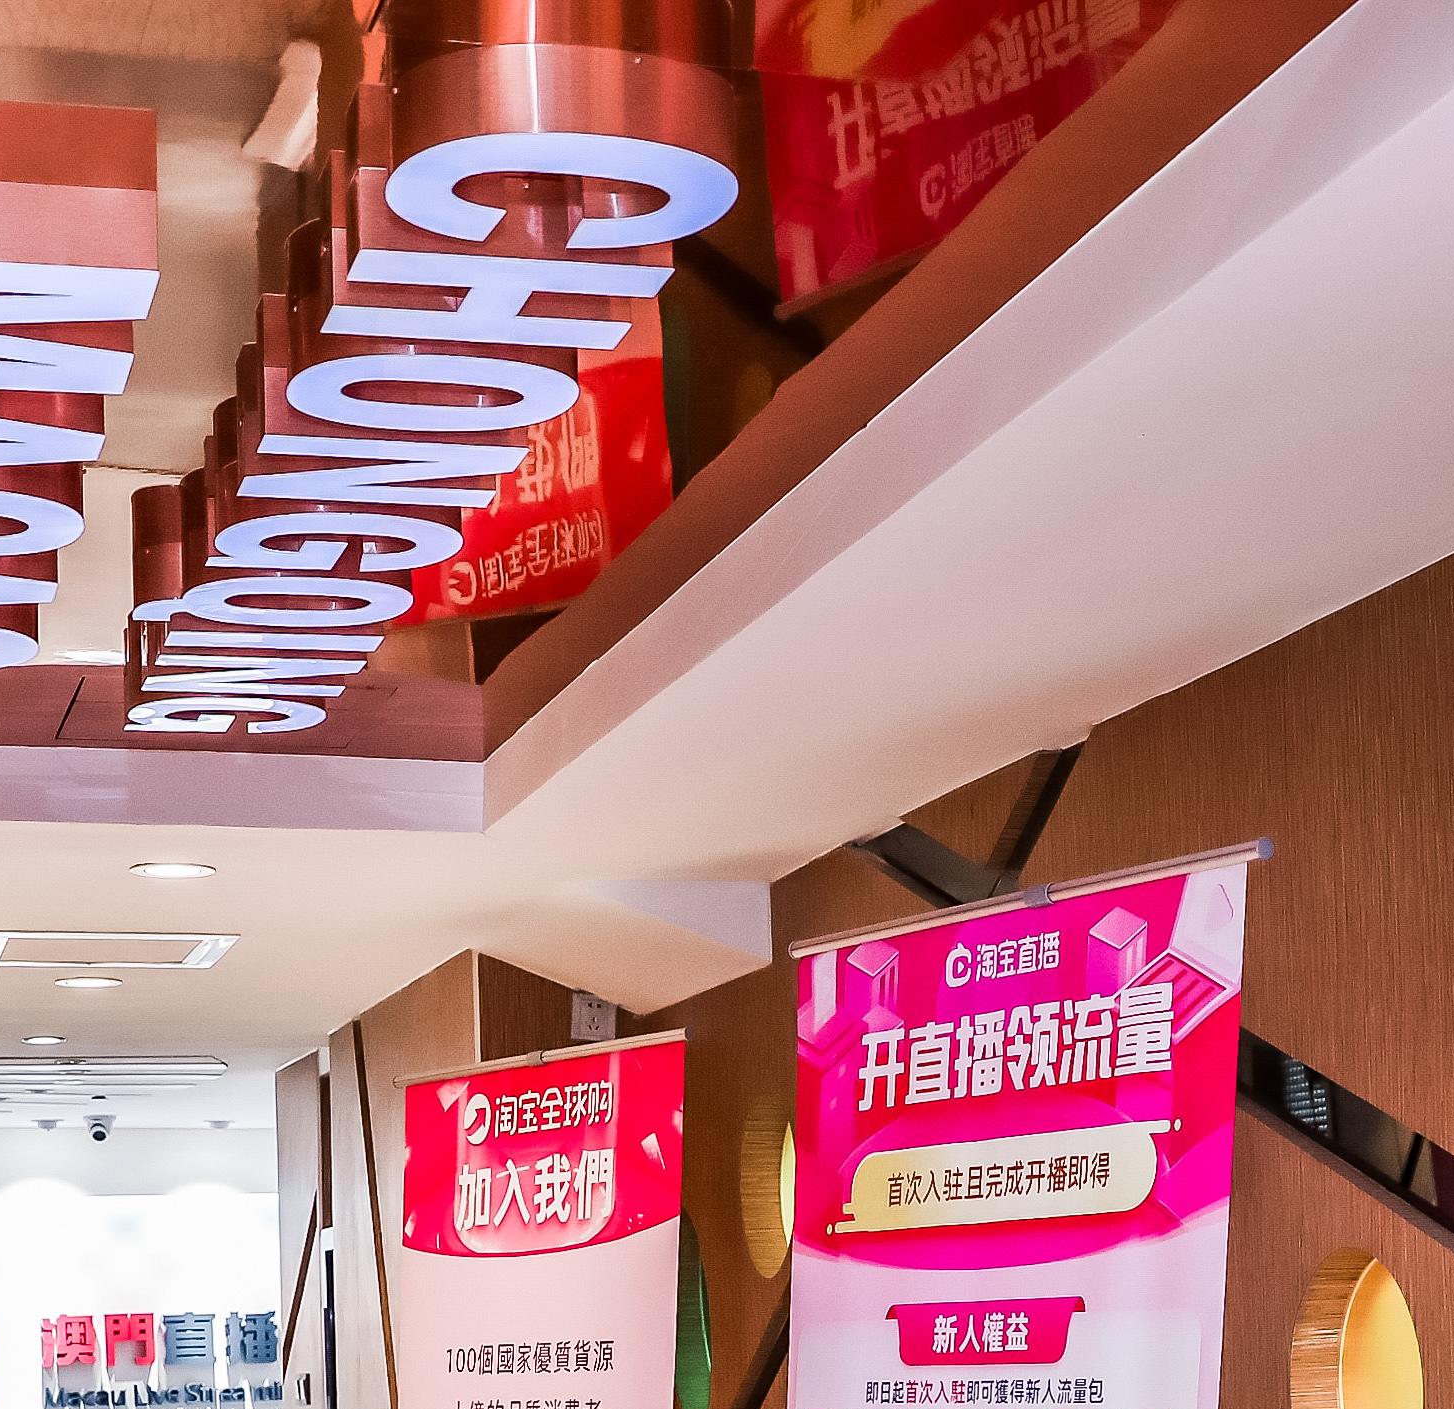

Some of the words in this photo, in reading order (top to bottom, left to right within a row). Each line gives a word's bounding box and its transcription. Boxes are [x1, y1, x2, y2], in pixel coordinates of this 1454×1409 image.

[123, 130, 740, 736] CHONGQING
[976, 931, 1061, 980] 淘宝直播
[857, 981, 1175, 1112] 开直播领流量
[495, 1080, 614, 1139] 淘宝全球购
[456, 1147, 615, 1231] 加入我們
[887, 1152, 1111, 1208] 首次入驻且完成开播即得
[447, 1340, 615, 1375] 100個國家優質貨源
[932, 1312, 1030, 1354] 新人權益
[45, 1385, 127, 1408] Macau
[183, 1381, 284, 1405] Streami
